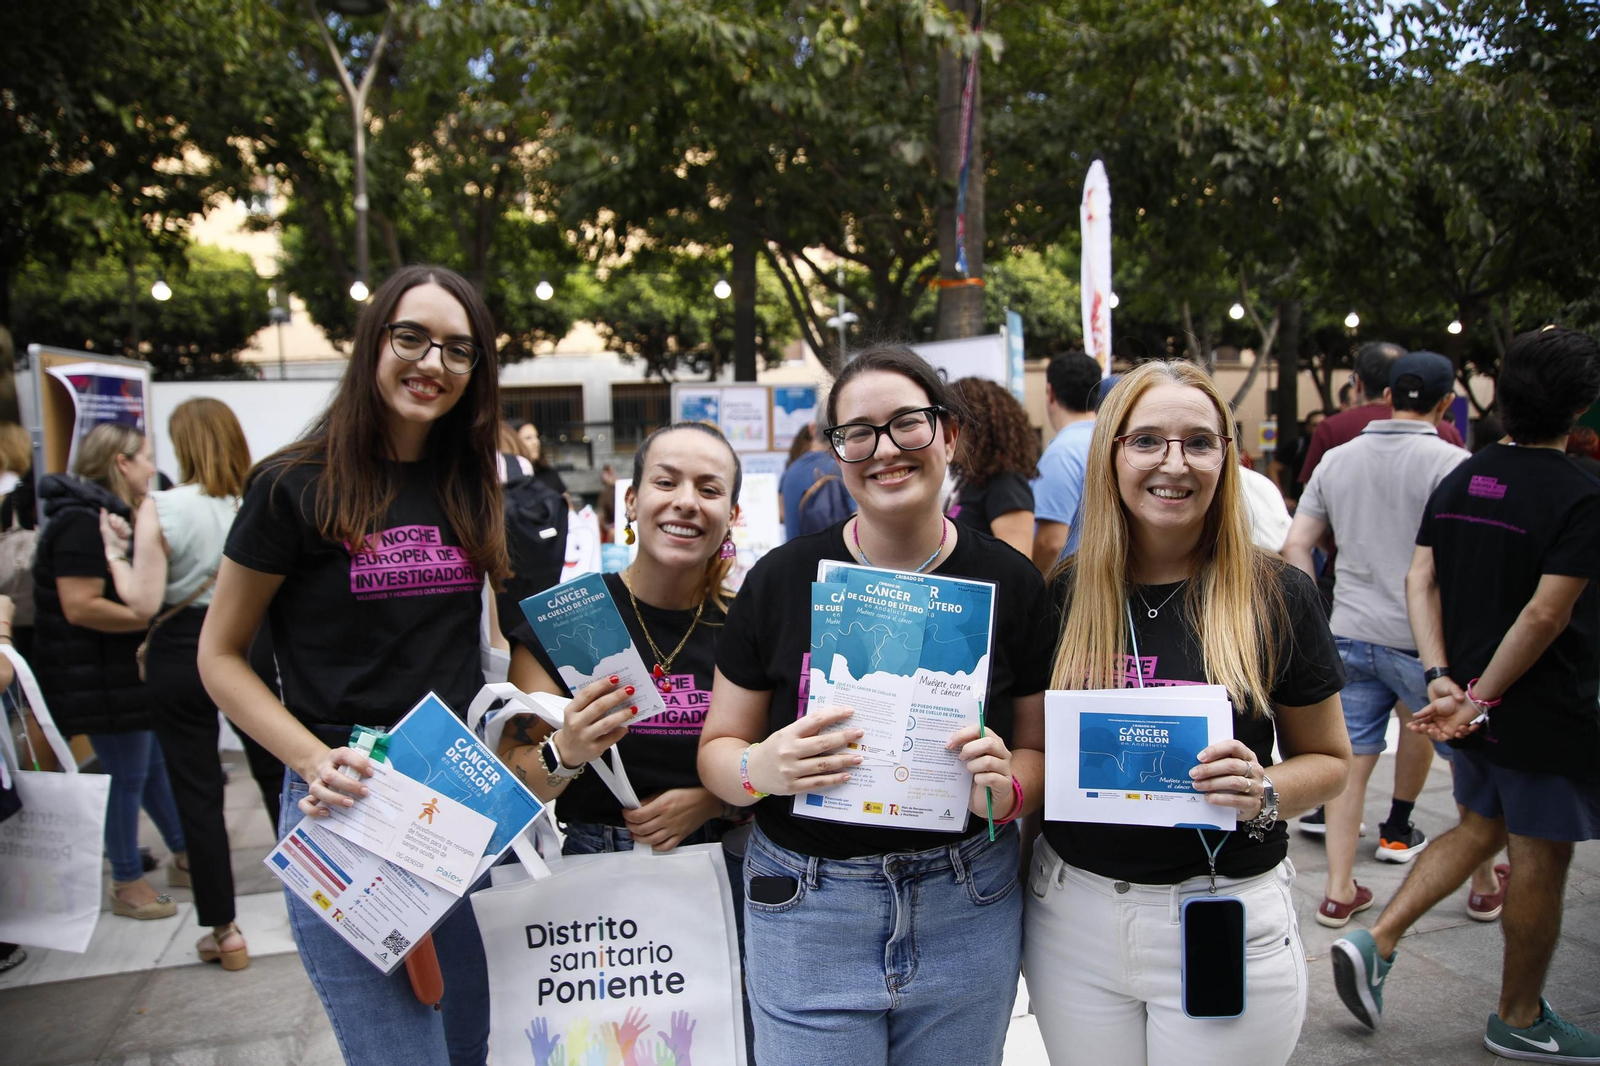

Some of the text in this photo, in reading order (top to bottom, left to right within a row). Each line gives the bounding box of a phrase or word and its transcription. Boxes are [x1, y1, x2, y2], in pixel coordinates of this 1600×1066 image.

[381, 528, 438, 547] NOCHE
[355, 549, 433, 567] EUROPEA
[436, 549, 457, 562] DE
[355, 565, 478, 590] INVESTIGADOR
[895, 574, 917, 582] CRIBADO
[547, 587, 589, 609] CÁNCER
[866, 584, 911, 602] CÁNCER
[537, 592, 606, 622] DE CUELLO DE ÚTERO
[847, 592, 858, 600] DE
[858, 594, 886, 606] CUELLO
[888, 601, 898, 609] DE
[898, 602, 924, 614] ÚTERO
[874, 605, 906, 616] Andalucía
[928, 599, 963, 614] ÚTERO
[940, 688, 962, 697] cáncer
[950, 682, 972, 691] contra
[687, 692, 710, 705] DE
[1119, 726, 1169, 737] CÁNCER
[1134, 736, 1169, 744] COLON
[445, 747, 493, 794] DE COLON
[454, 738, 501, 785] CÁNCER
[441, 756, 482, 798] en Andalucía
[405, 834, 440, 854] determinación
[411, 821, 446, 842] Procedimiento
[453, 843, 475, 858] recogida
[415, 831, 430, 842] heces
[430, 840, 442, 848] para
[402, 840, 435, 860] sangre oculta
[396, 852, 424, 870] OC-SENSOR
[436, 866, 464, 884] Palex
[525, 916, 638, 949] Distrito
[550, 940, 673, 973] sanitario
[538, 970, 685, 1006] Poniente
